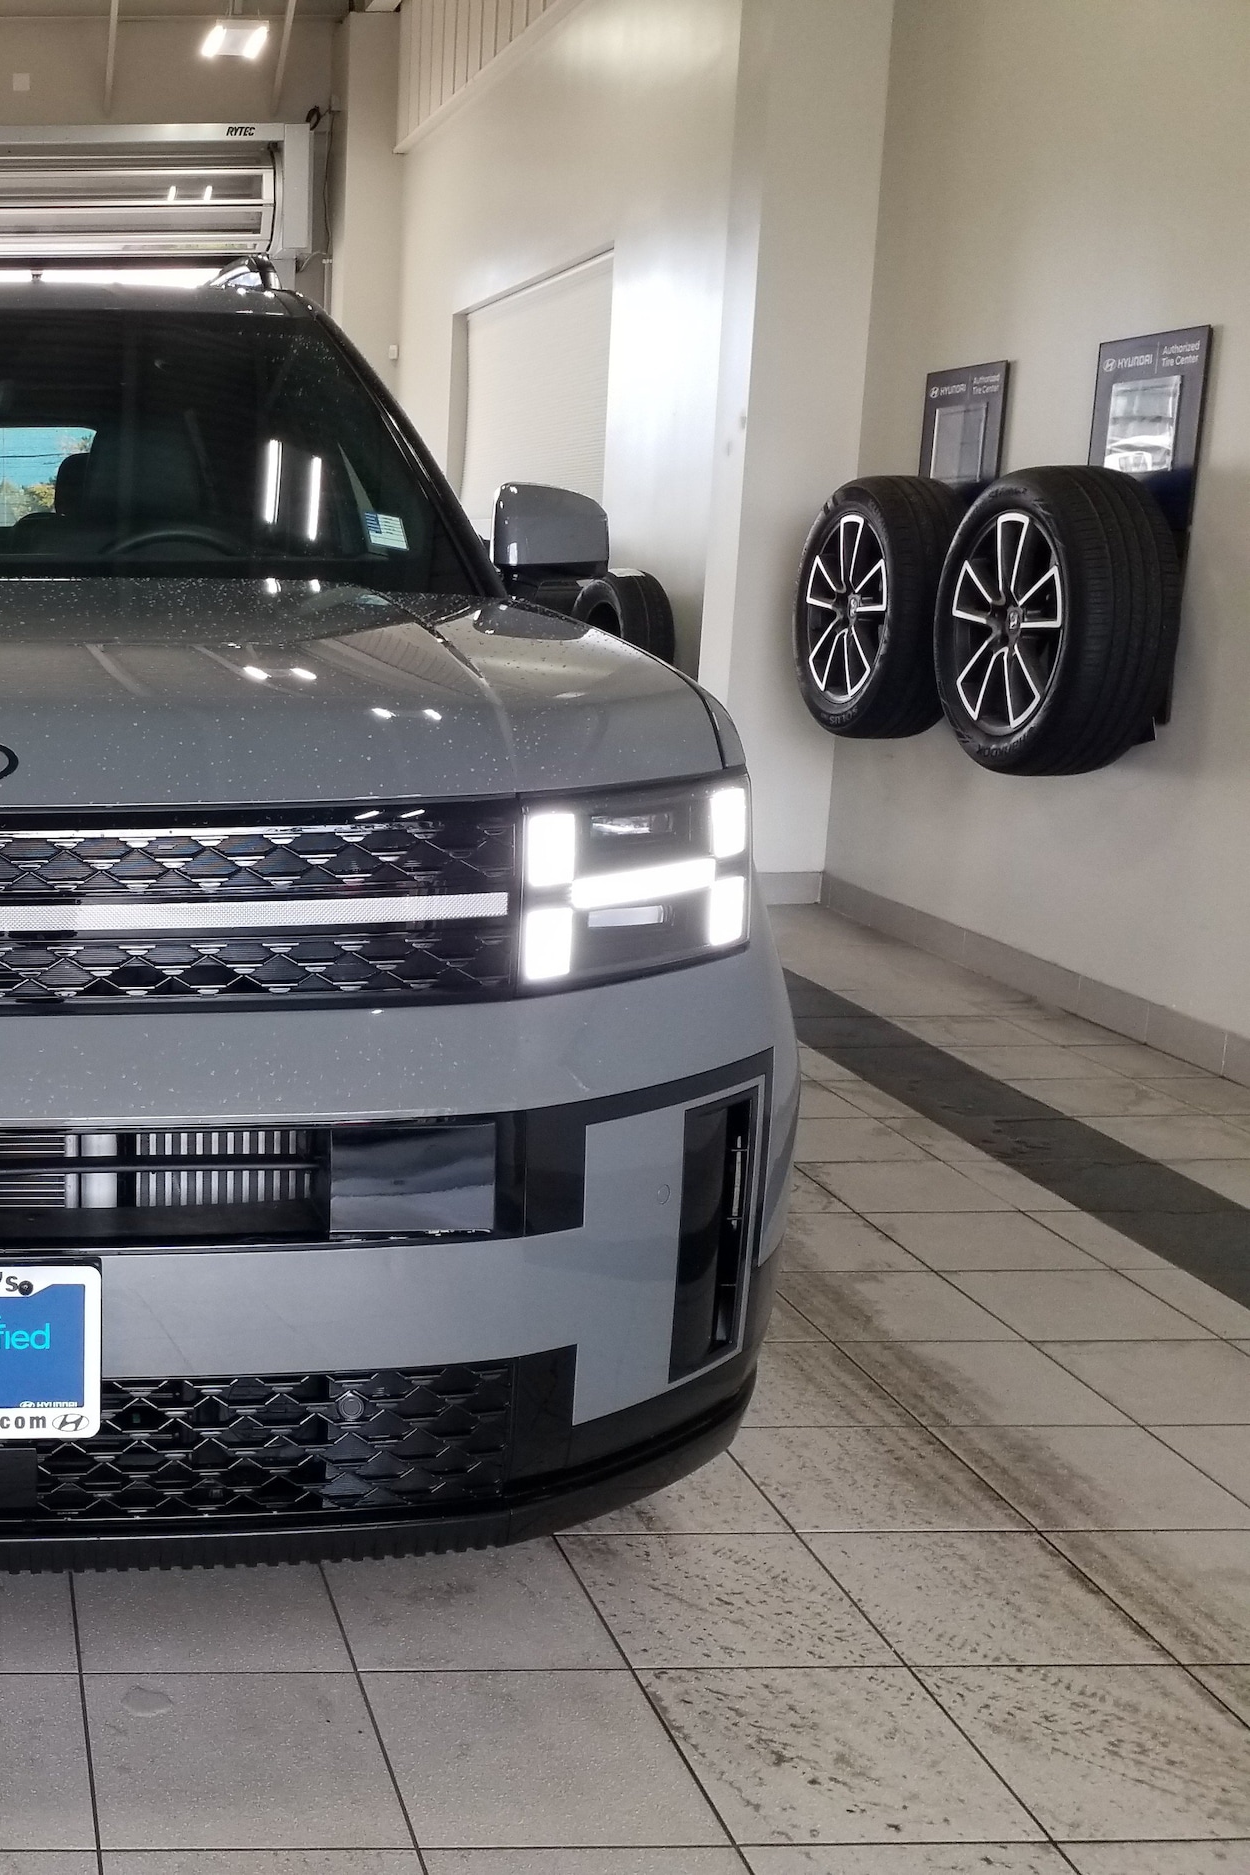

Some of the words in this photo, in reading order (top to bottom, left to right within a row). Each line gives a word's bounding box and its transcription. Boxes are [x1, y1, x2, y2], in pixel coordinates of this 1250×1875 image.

[226, 126, 256, 136] RYTEC
[1161, 341, 1201, 355] Authorized
[1117, 354, 1153, 369] HYUNDAI
[1162, 358, 1175, 367] Tire
[1175, 354, 1199, 366] Center
[940, 383, 967, 396] HYUNDAI
